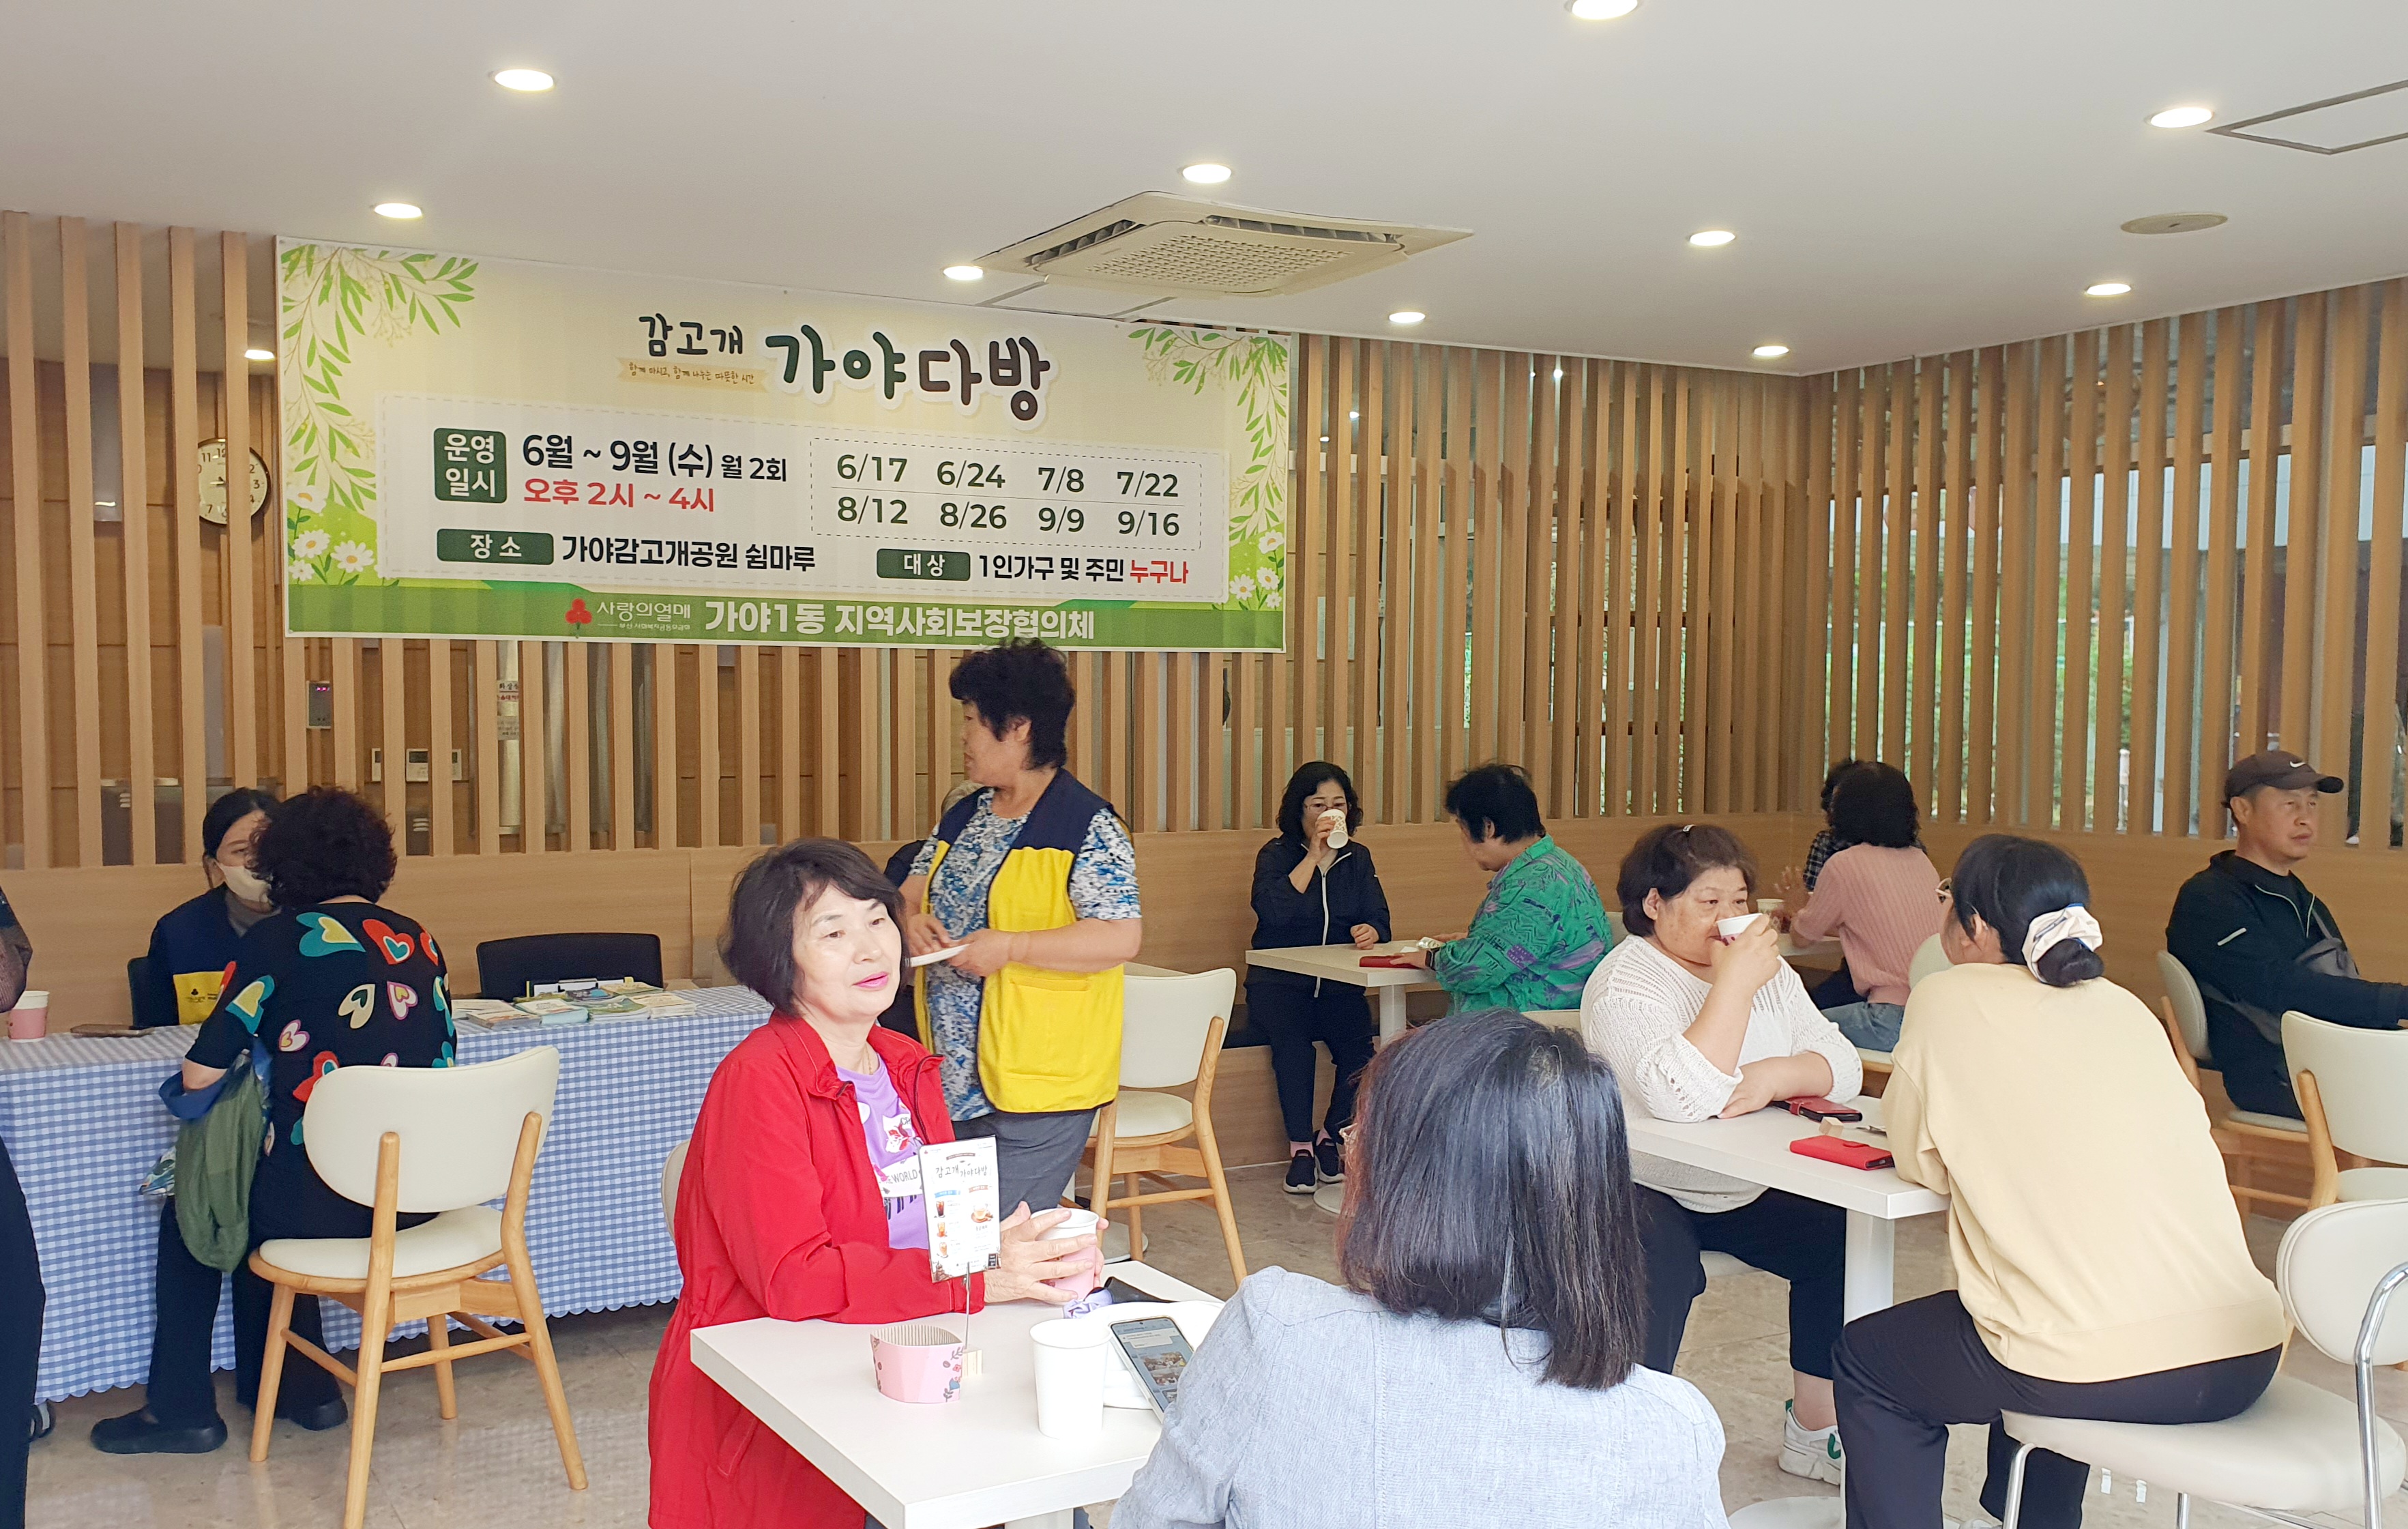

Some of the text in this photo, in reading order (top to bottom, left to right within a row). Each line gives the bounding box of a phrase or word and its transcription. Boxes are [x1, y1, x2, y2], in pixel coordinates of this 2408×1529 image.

[628, 362, 646, 377] 함께
[673, 366, 690, 380] 함께
[692, 369, 712, 381] 나누는
[715, 370, 739, 385] 따뜻한
[742, 373, 755, 385] 시간
[638, 312, 1051, 422] 감고개 가야다방
[443, 433, 495, 465] 운영
[523, 434, 573, 469] 6월
[609, 440, 659, 475] 9월
[668, 441, 714, 478] (수)
[720, 454, 743, 480] 월
[748, 457, 787, 482] 2회
[252, 479, 261, 489] 3
[445, 467, 496, 498] 일시
[836, 453, 1179, 498] 6/17 6/24 7/8 7/22
[523, 478, 580, 505] 오후
[587, 482, 634, 508] 2시
[669, 487, 714, 512] 4시
[837, 495, 1180, 538] 8/12 8/26 9/9 9/16
[562, 536, 816, 572] 가야감고개공원 쉼마루
[979, 555, 1189, 584] 1인가구 및 주민 누구나
[596, 601, 691, 622] 사랑의열매
[705, 600, 1095, 640] 가야1동 지역사회보장협의체
[891, 1169, 918, 1184] WORLD
[935, 1164, 988, 1178] 감고개 가야다방
